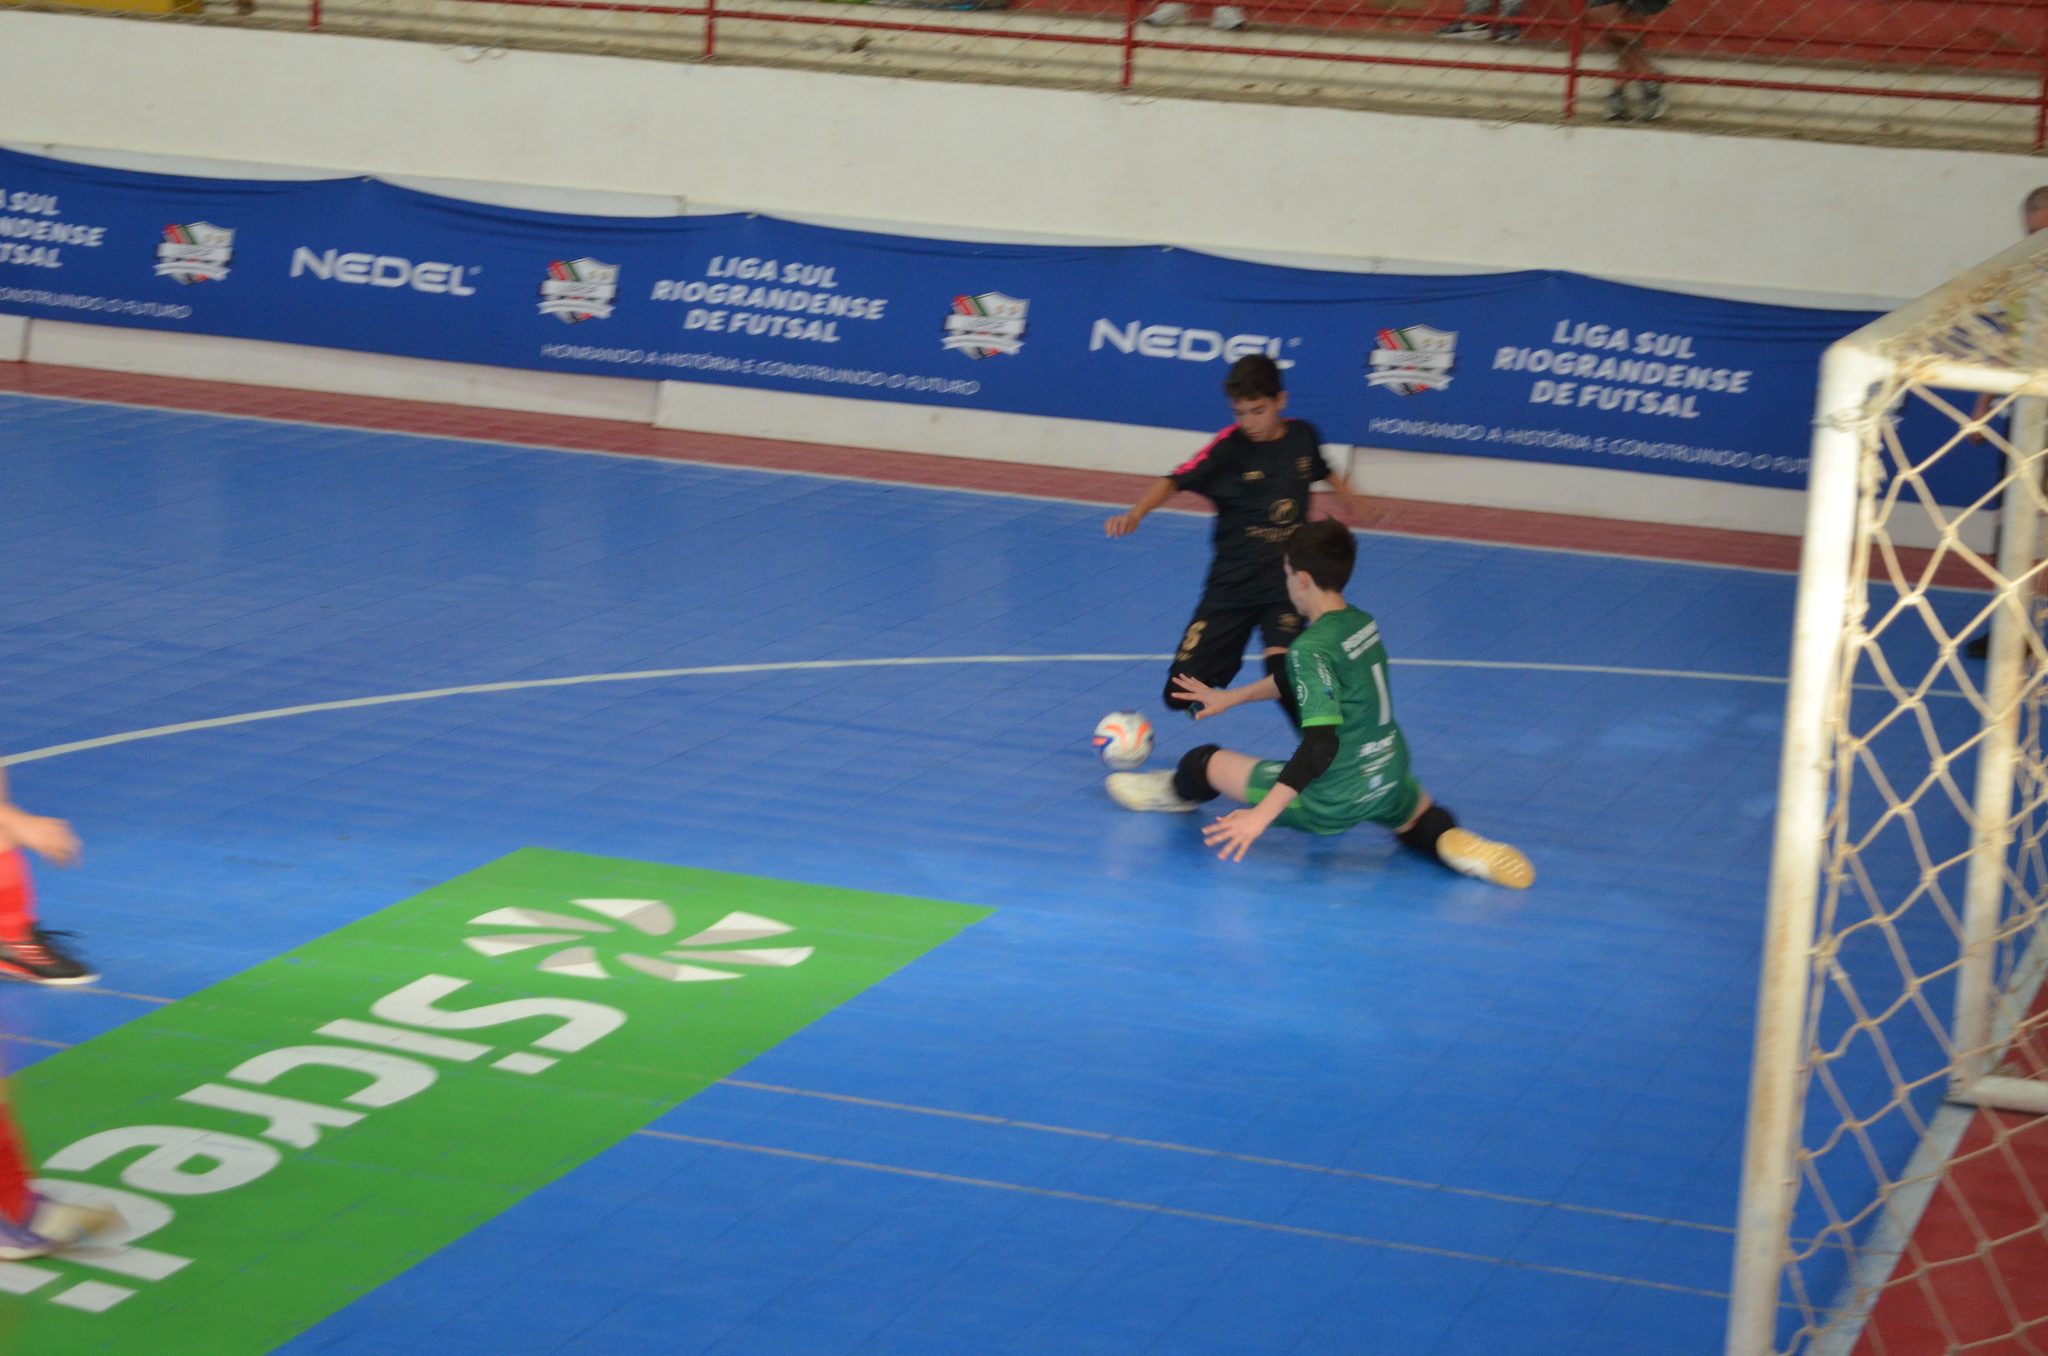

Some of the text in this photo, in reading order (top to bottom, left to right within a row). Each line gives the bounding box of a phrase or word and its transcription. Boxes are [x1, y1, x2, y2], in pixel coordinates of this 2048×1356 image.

[8, 191, 61, 216] SUL
[289, 246, 477, 297] NEDEL
[705, 255, 839, 289] LIGA SUL
[650, 279, 890, 320] RIOGRANDENSE
[683, 308, 842, 343] DE FUTSAL
[1552, 319, 1698, 359] LIGA SUL
[1491, 346, 1755, 394] RIOGRANDENSE
[1529, 379, 1701, 419] DE FUTSAL
[1370, 661, 1392, 727] 1
